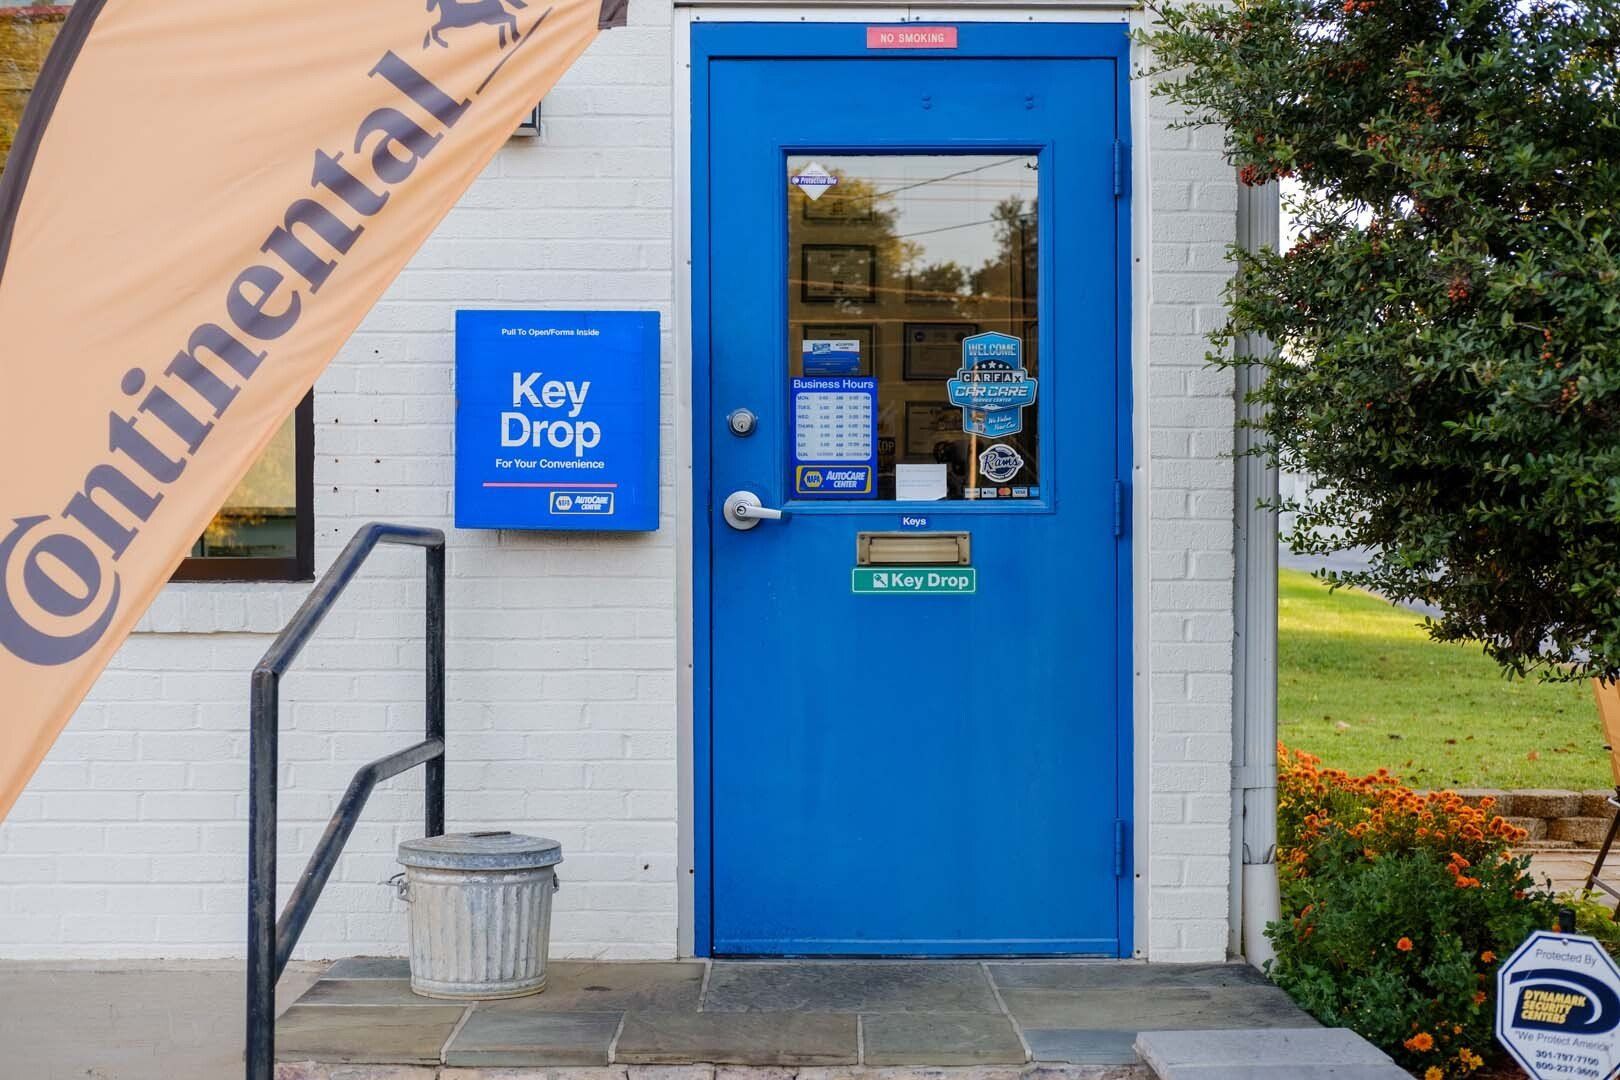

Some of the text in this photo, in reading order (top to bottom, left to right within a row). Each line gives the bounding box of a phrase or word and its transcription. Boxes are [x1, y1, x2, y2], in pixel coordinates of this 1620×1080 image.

[880, 33, 945, 43] NO SMOKING
[501, 328, 600, 338] Pull To Open/Forms Inside
[968, 343, 1017, 356] WELCOME
[0, 50, 472, 667] Continental
[793, 379, 874, 389] Business Hours
[962, 373, 1023, 383] CARFAX
[512, 372, 591, 417] Key
[954, 386, 1029, 397] CAR CARE
[501, 412, 601, 457] Drop
[495, 458, 605, 469] For Your Convenience
[984, 451, 1018, 470] Rams
[833, 480, 858, 488] CENTER
[903, 516, 927, 527] Keys
[891, 573, 969, 590] Key Drop
[1535, 948, 1597, 967] Protected By
[1524, 989, 1587, 1007] DYNAMARK
[1522, 1000, 1573, 1014] SECURITY
[1521, 1010, 1567, 1024] CENTERS
[1536, 1032, 1571, 1046] Protect
